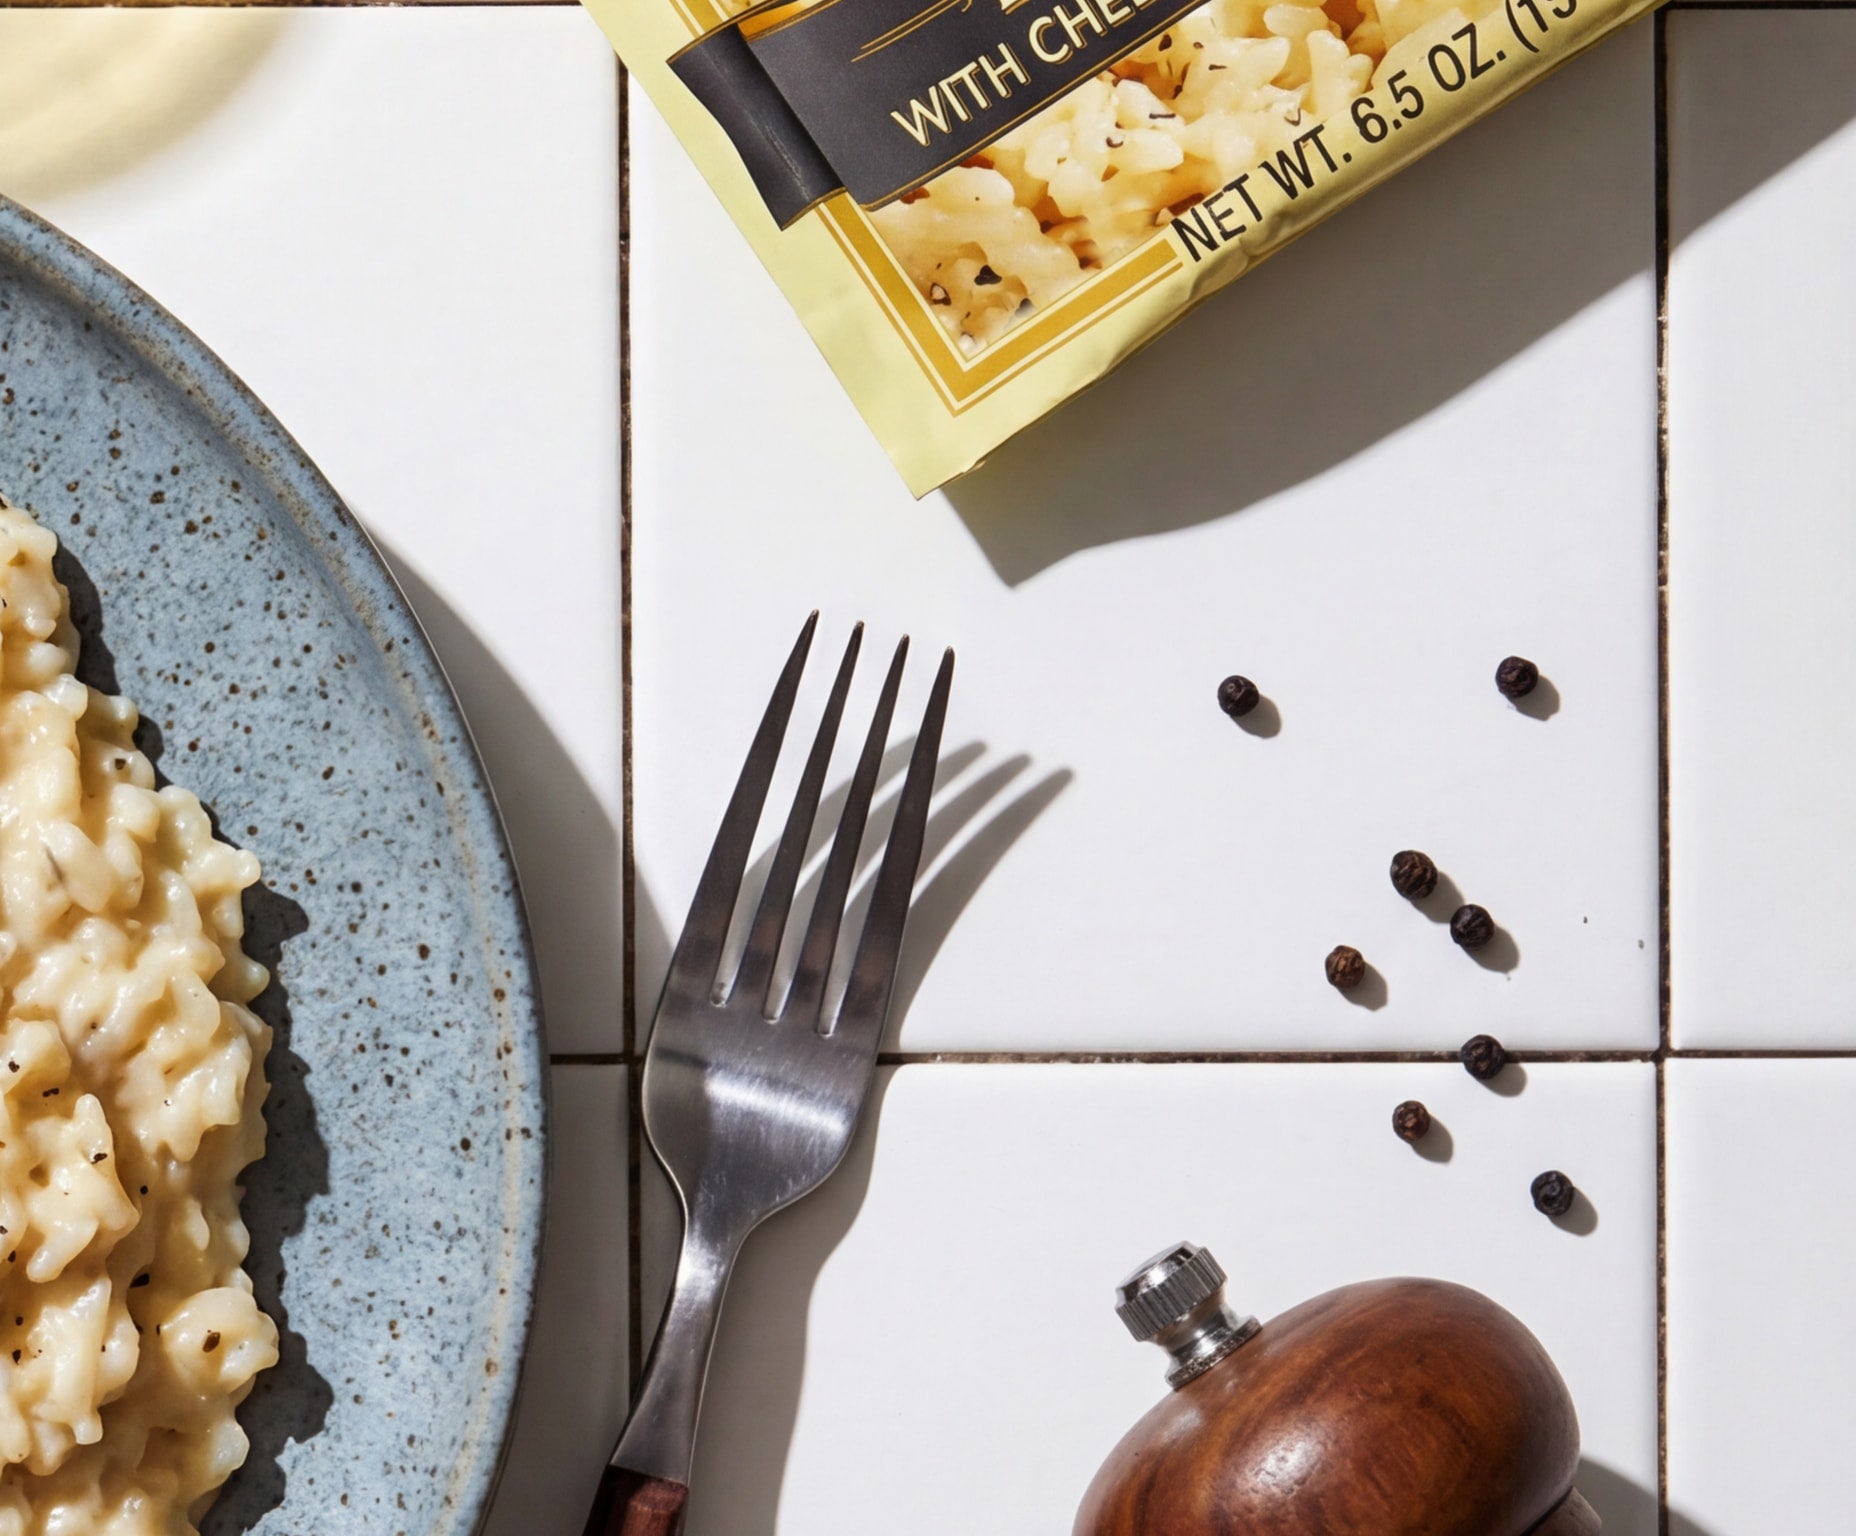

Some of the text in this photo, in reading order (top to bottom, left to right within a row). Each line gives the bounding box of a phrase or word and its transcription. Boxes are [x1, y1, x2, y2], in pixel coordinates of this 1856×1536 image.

[891, 44, 1031, 148] WITH
[1171, 173, 1263, 262] NET
[1258, 124, 1352, 200] WT.
[1350, 70, 1428, 144] 6.5
[1425, 23, 1507, 95] OZ.
